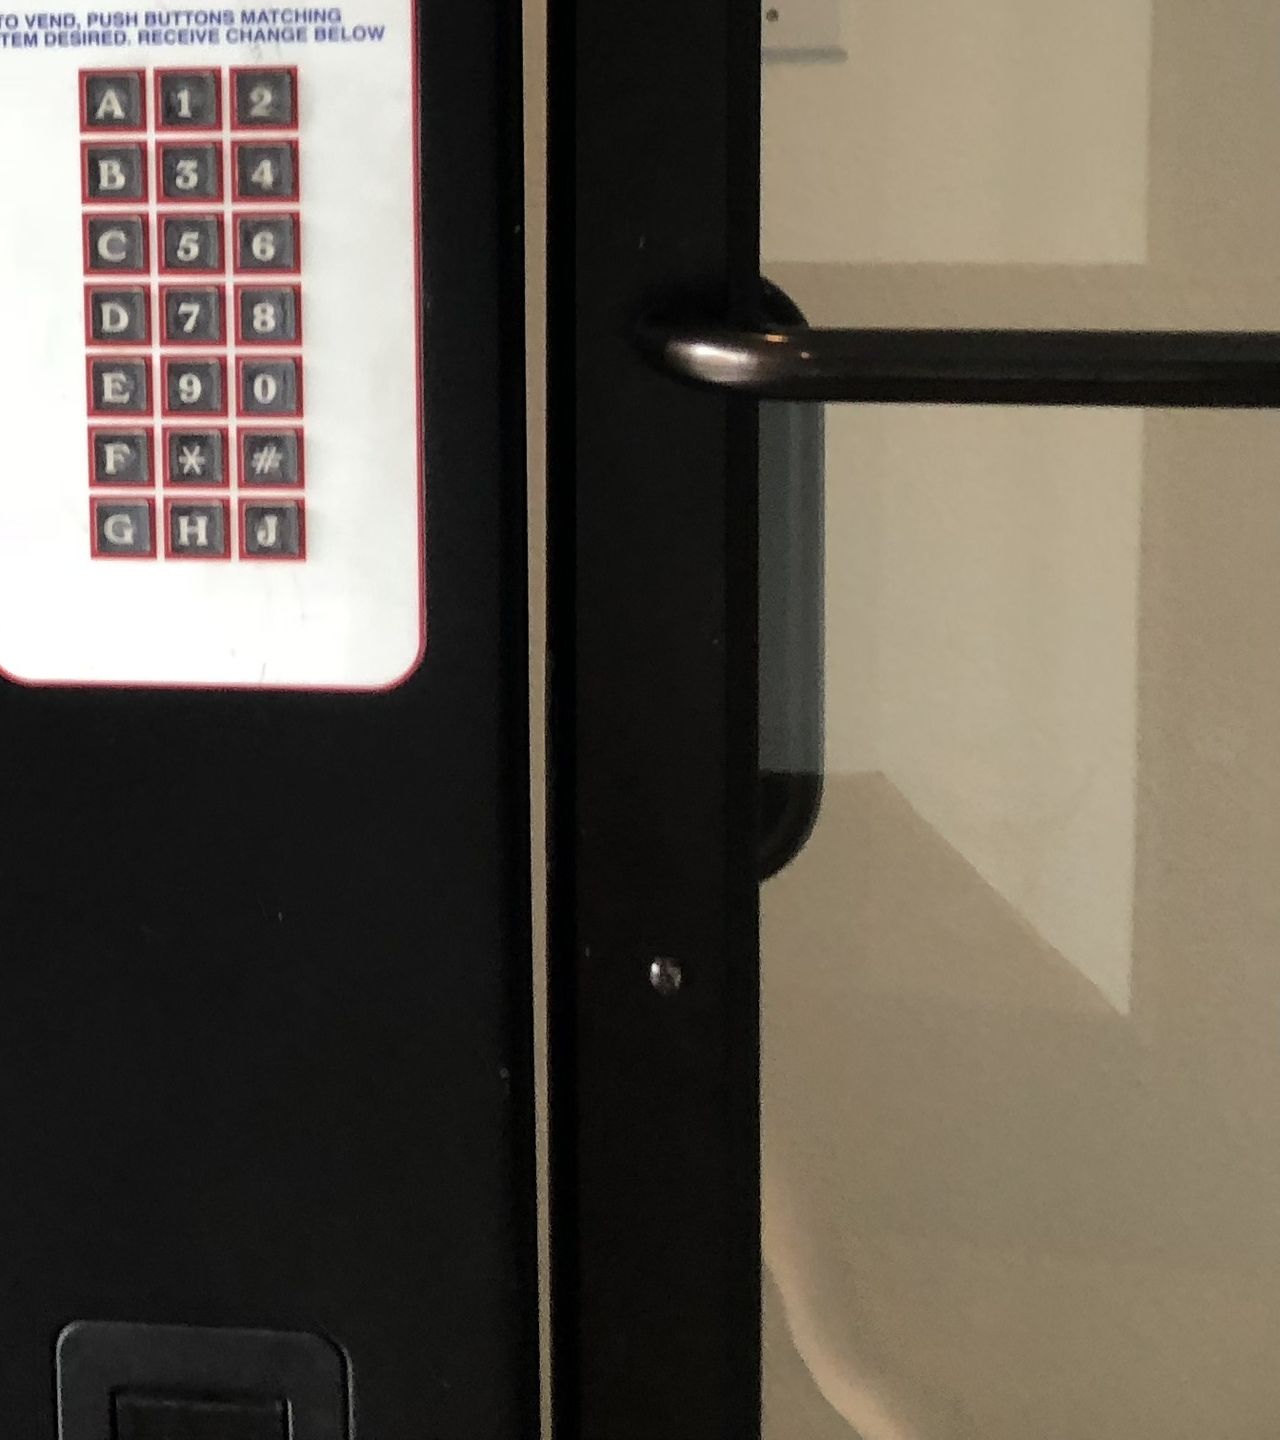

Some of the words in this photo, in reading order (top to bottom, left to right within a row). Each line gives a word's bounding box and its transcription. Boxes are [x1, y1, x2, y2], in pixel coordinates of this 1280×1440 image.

[87, 12, 138, 28] PUSH
[145, 10, 235, 27] BUTTONS
[241, 8, 341, 26] MATCHING
[138, 28, 220, 45] RECEIVE
[226, 26, 307, 44] CHANGE
[315, 25, 386, 42] BELOW
[96, 88, 125, 120] A
[176, 87, 192, 118] 1
[249, 85, 273, 117] 2
[98, 159, 126, 191] B
[175, 159, 199, 190] 3
[252, 159, 273, 190] 4
[98, 230, 127, 262] C
[176, 231, 200, 262] 5
[252, 230, 275, 262] 6
[101, 302, 129, 333] D
[178, 302, 200, 333] 7
[252, 302, 276, 333] 8
[102, 372, 130, 404] E
[178, 373, 202, 404] 9
[104, 443, 131, 475] F
[103, 514, 134, 545] G
[178, 515, 208, 546] H
[256, 515, 278, 547] J
